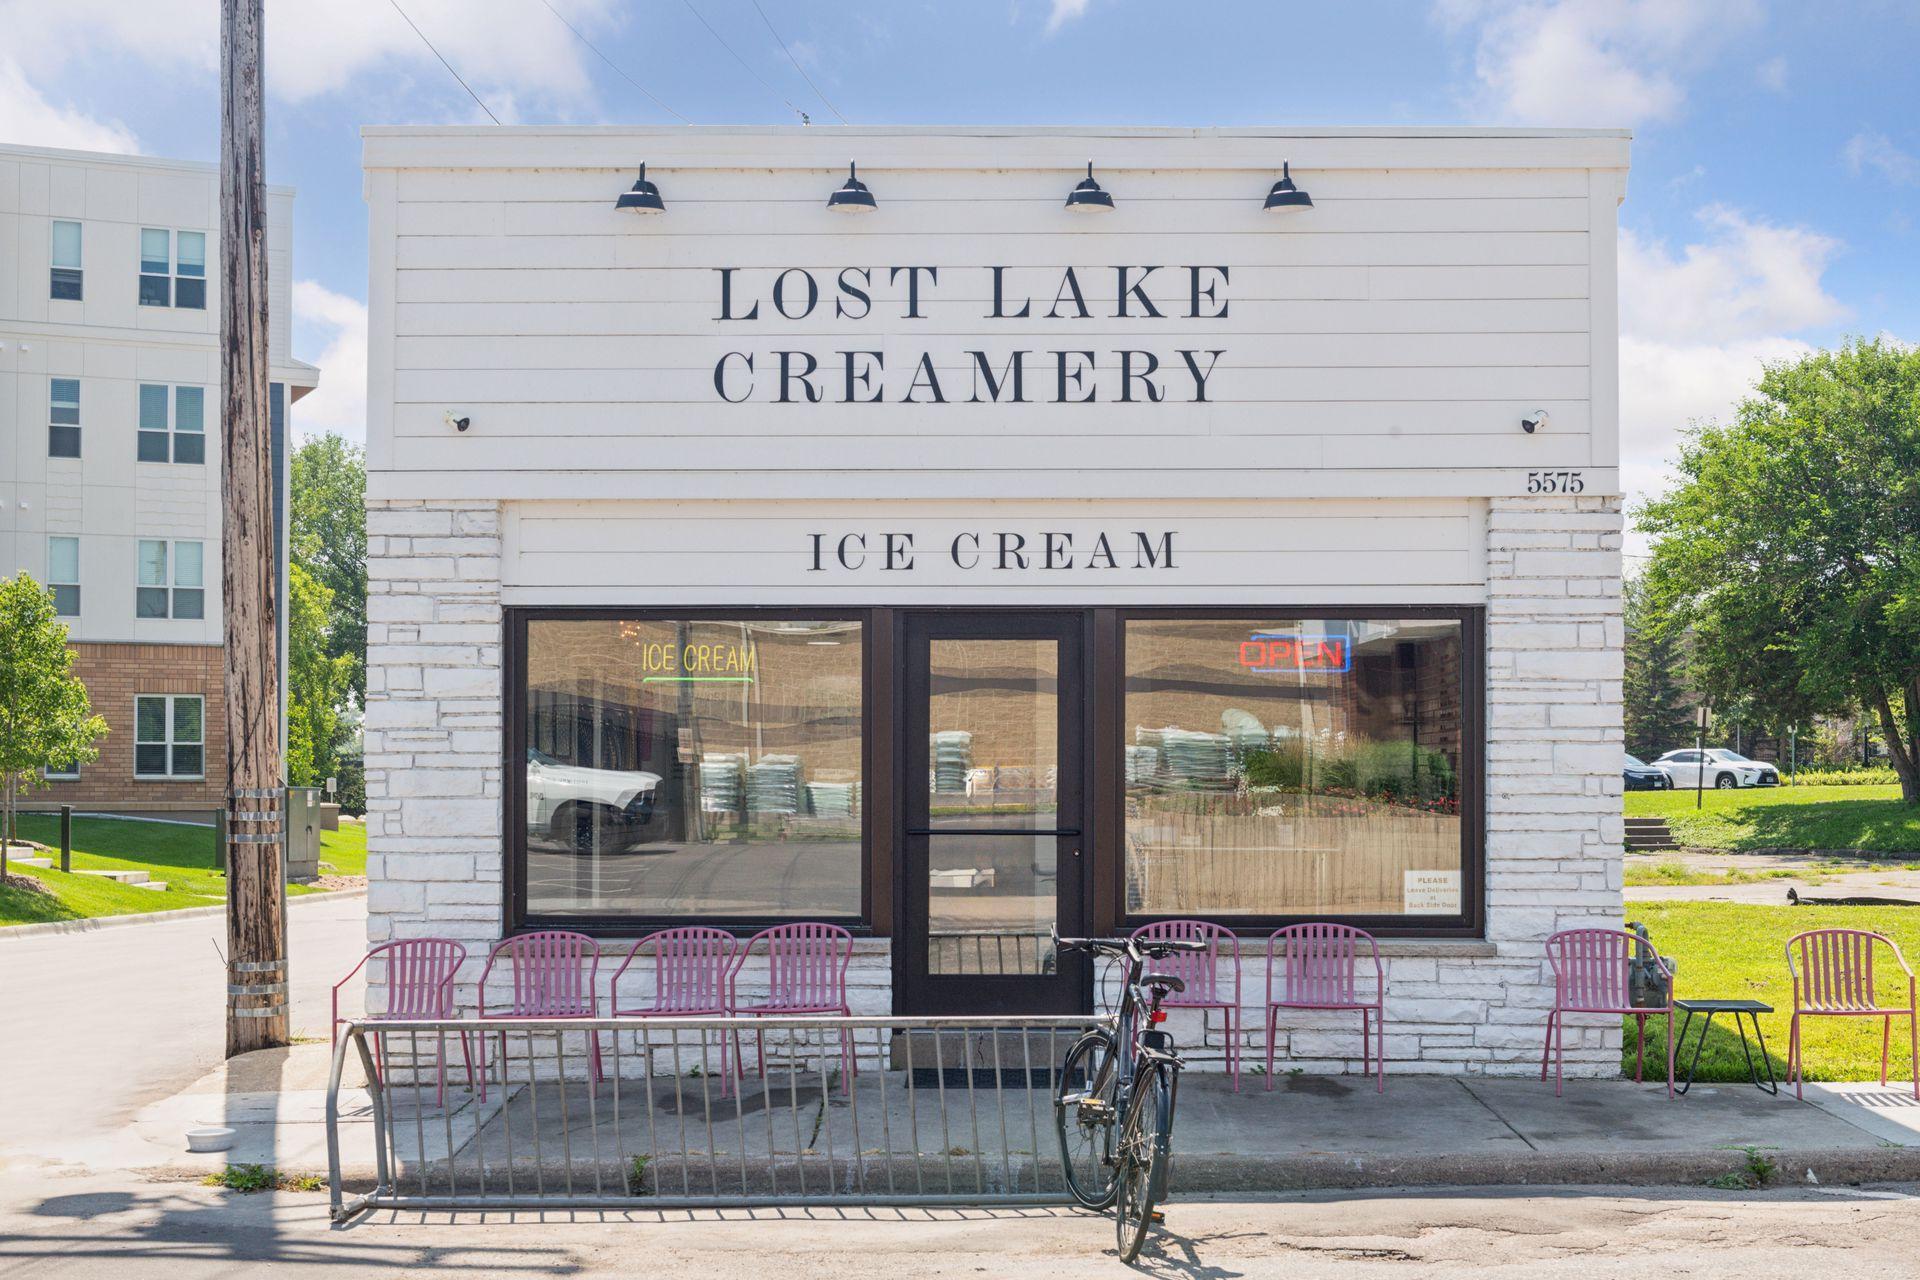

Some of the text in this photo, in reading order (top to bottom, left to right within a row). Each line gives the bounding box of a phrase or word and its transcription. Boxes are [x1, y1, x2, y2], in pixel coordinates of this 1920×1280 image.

[711, 265, 1229, 320] LOST LAKE
[713, 350, 1227, 403] CREAMERY
[1527, 471, 1584, 493] 5575
[806, 531, 1180, 571] ICE CREAM
[642, 643, 755, 672] ICE CREAM
[1239, 640, 1343, 667] OPEN
